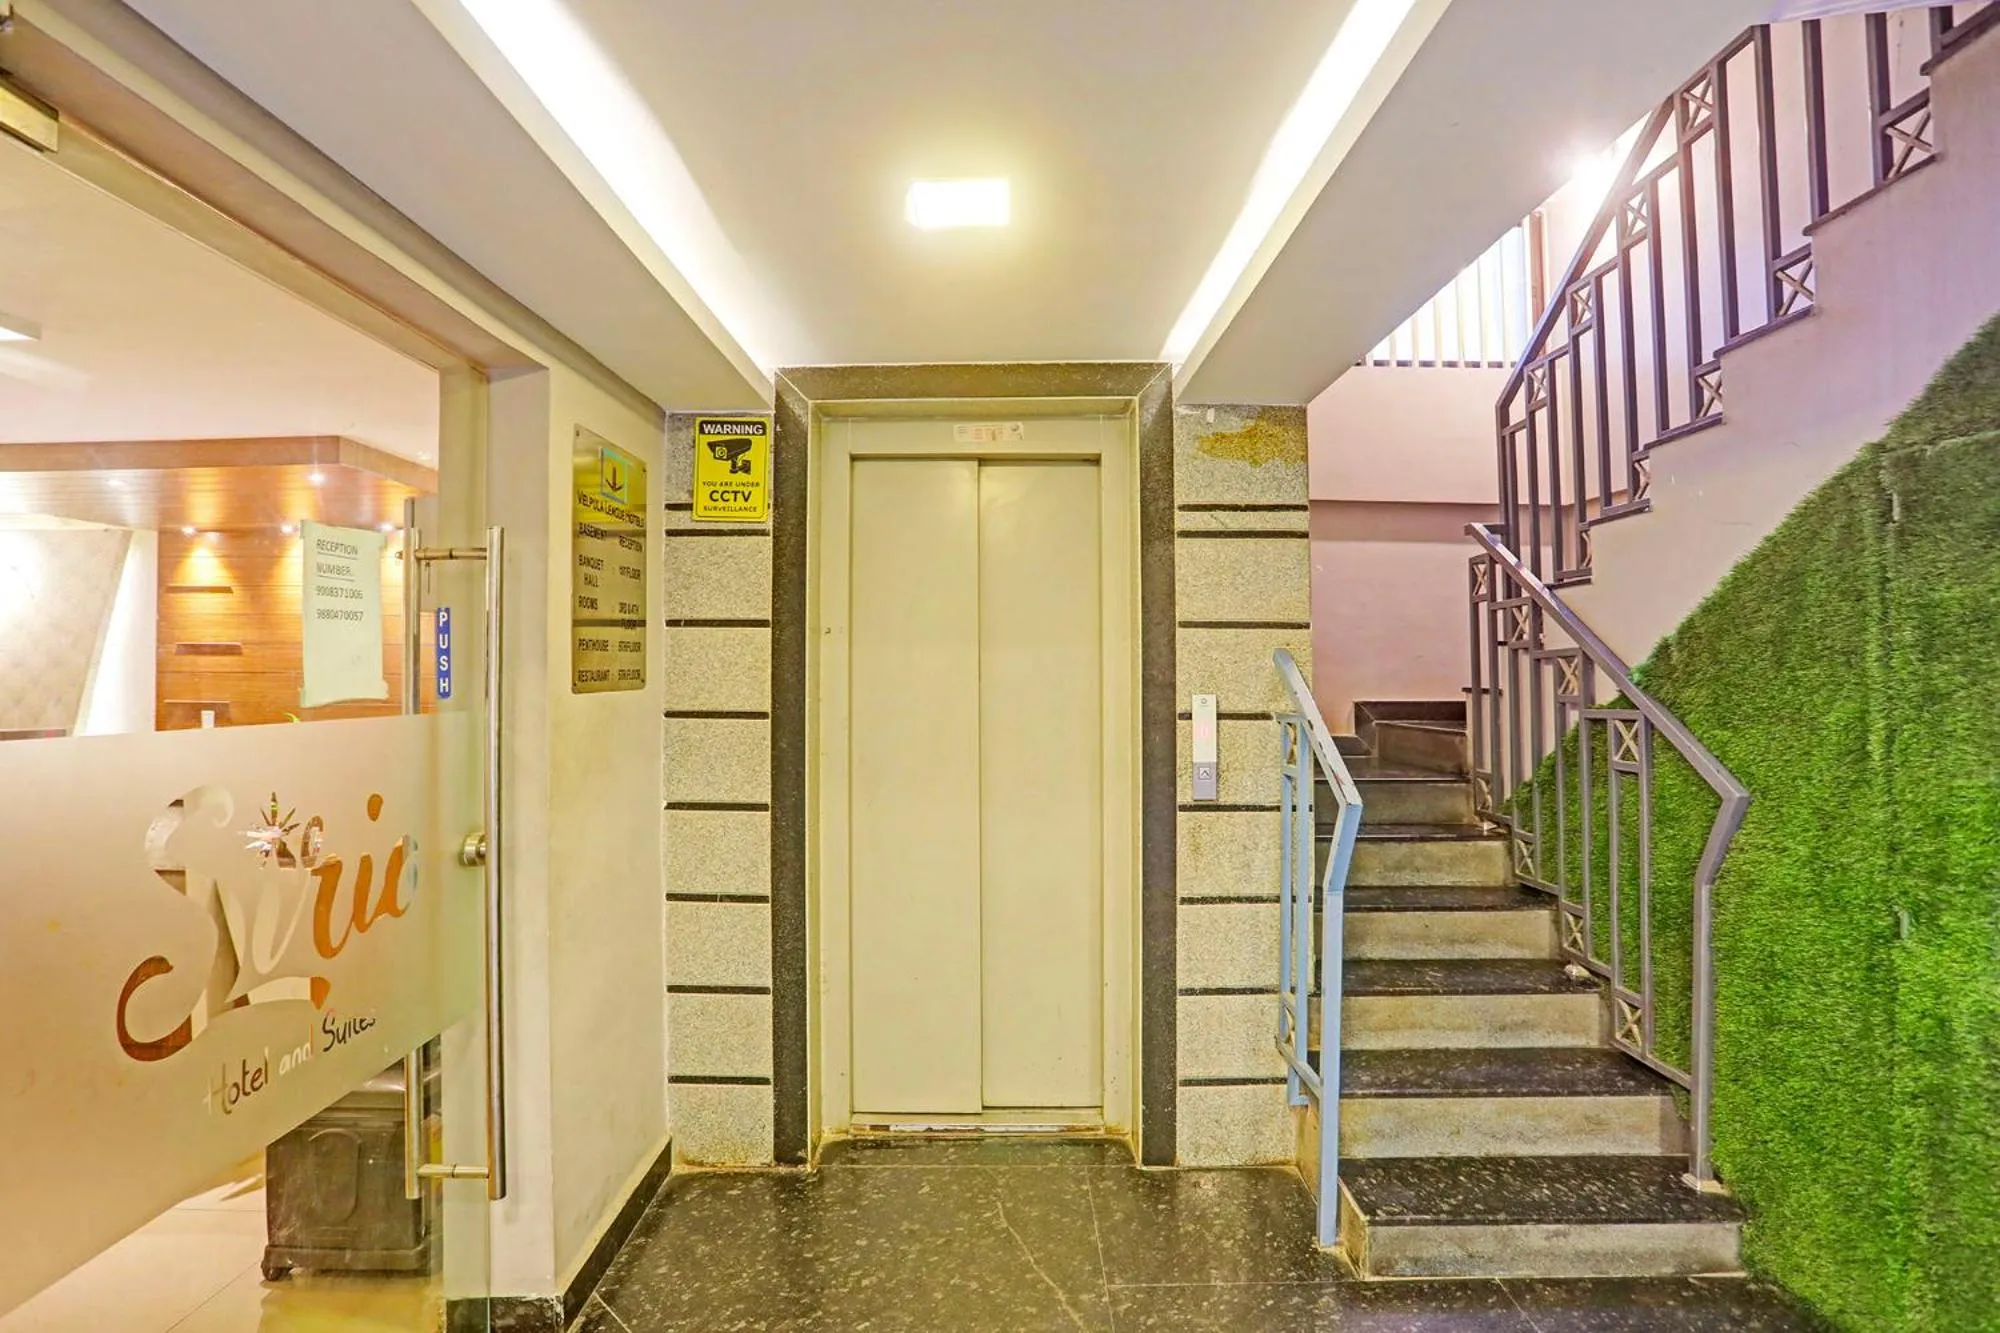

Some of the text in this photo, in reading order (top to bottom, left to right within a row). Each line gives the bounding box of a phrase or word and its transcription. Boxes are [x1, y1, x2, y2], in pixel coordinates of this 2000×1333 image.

[702, 423, 764, 434] WARNING
[709, 490, 752, 502] CCTV
[316, 539, 358, 555] RECEPTION
[583, 573, 600, 587] HALL
[578, 595, 598, 610] ROOMS
[438, 612, 449, 692] PUSH
[202, 1046, 269, 1115] Hotel
[279, 1023, 315, 1076] and
